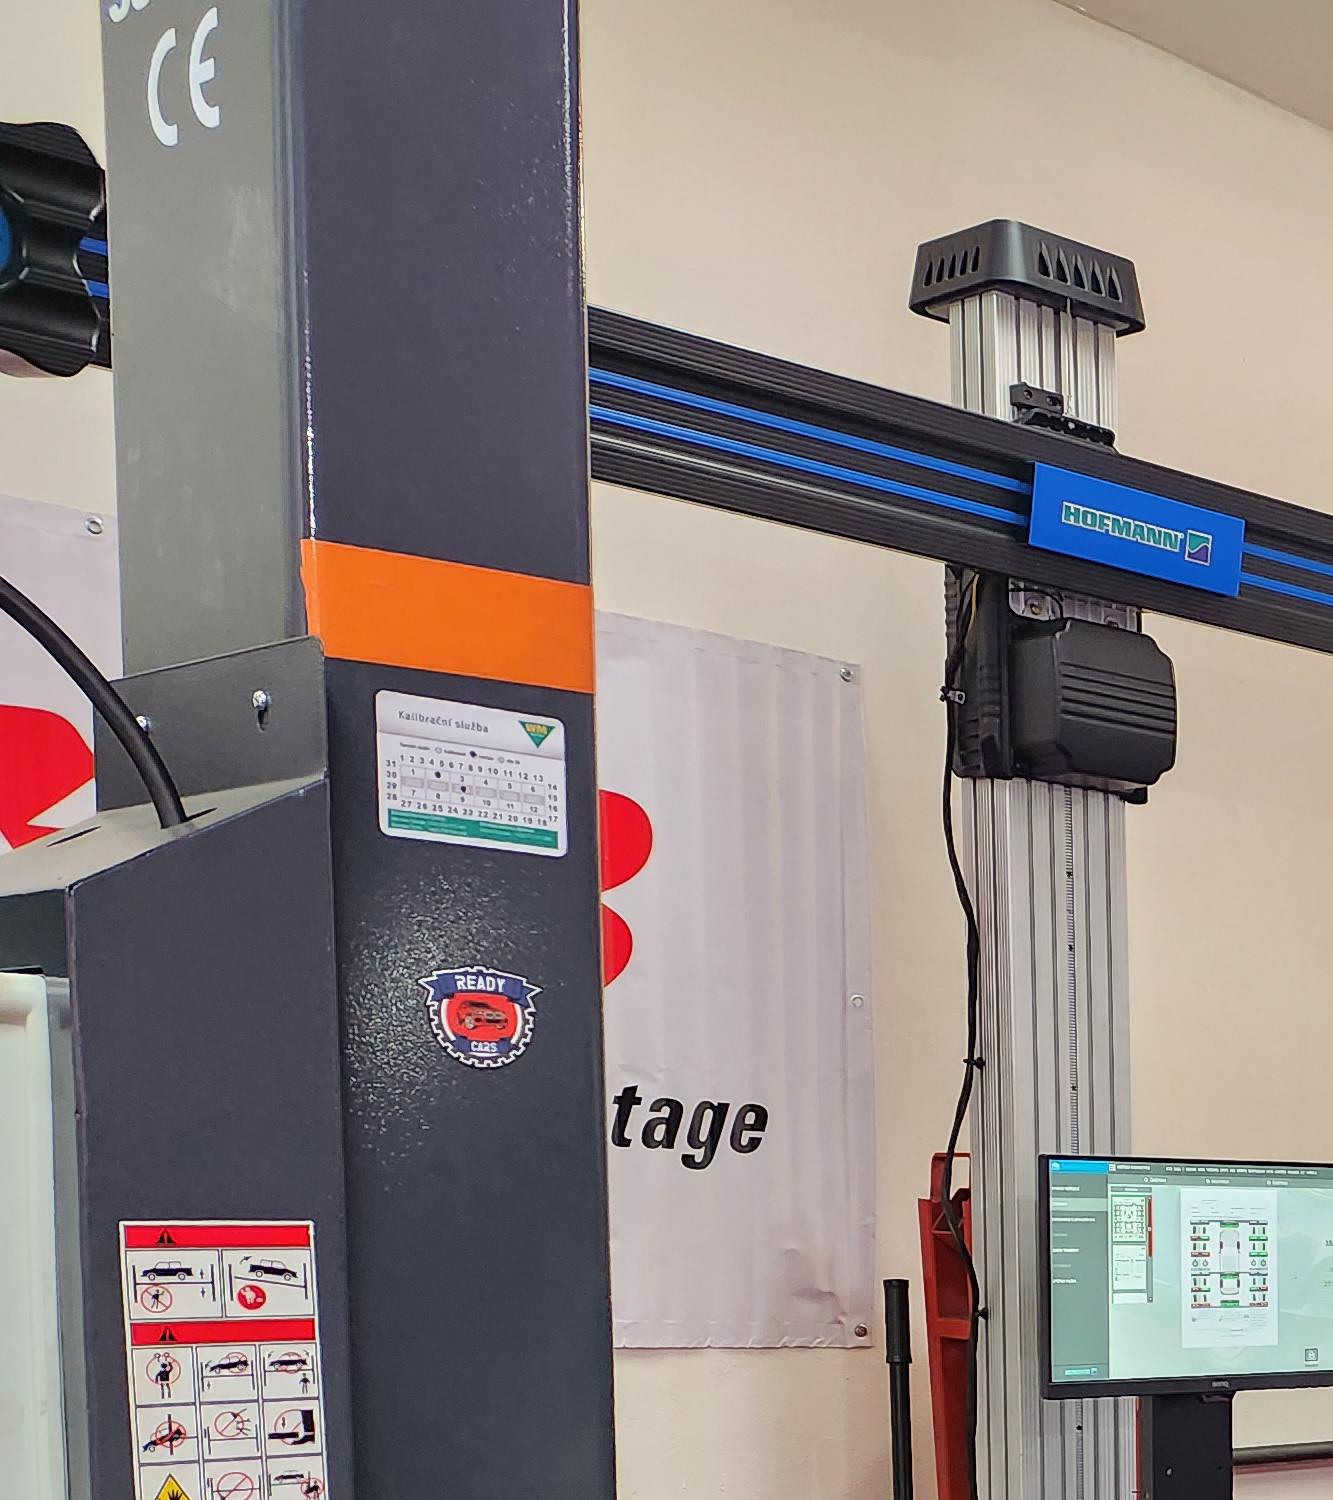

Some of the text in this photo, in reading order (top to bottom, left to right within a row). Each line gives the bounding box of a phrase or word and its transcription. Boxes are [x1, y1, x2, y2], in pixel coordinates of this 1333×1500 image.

[1062, 501, 1180, 552] HOFMANN
[398, 710, 489, 733] Kalibrační služba
[454, 975, 506, 992] READY
[470, 1041, 498, 1052] CARS
[610, 1084, 769, 1170] tage
